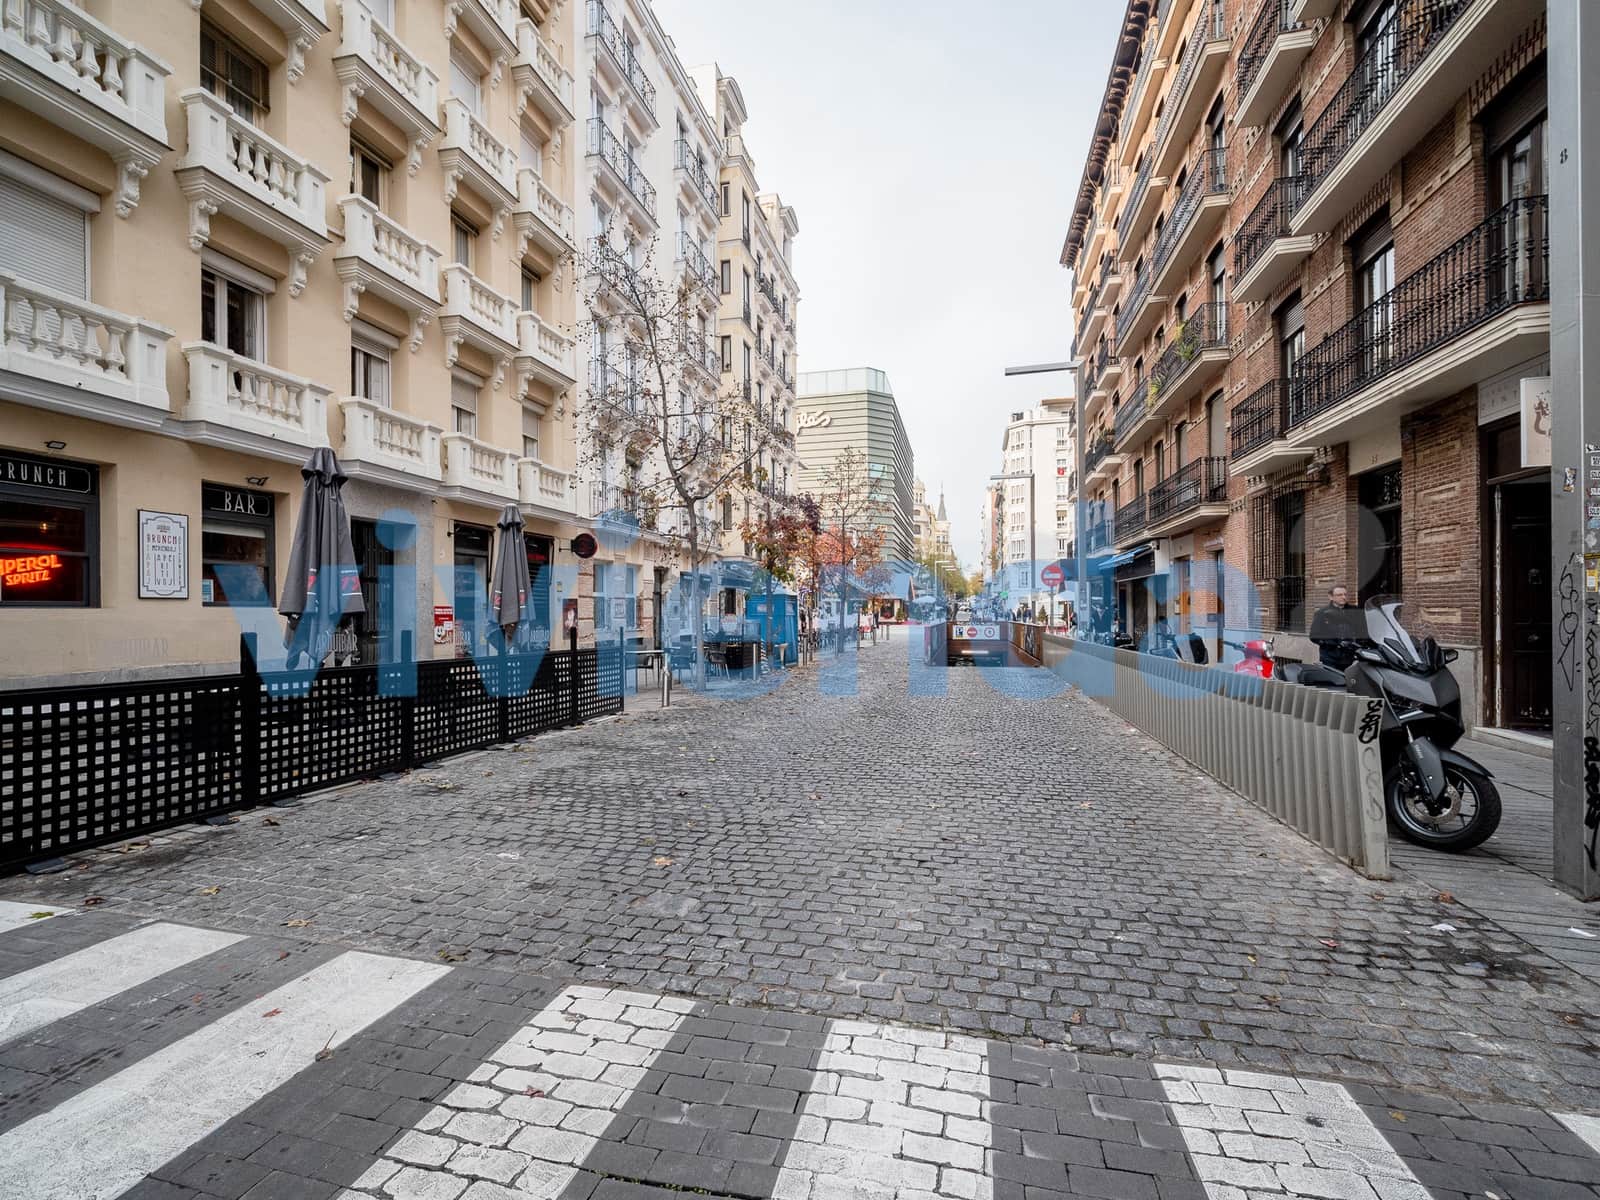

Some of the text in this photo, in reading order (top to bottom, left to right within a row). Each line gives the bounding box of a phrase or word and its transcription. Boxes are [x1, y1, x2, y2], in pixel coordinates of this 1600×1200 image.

[0, 462, 67, 487] RUNCH
[224, 490, 256, 515] BAR
[6, 569, 51, 586] SPRITZ
